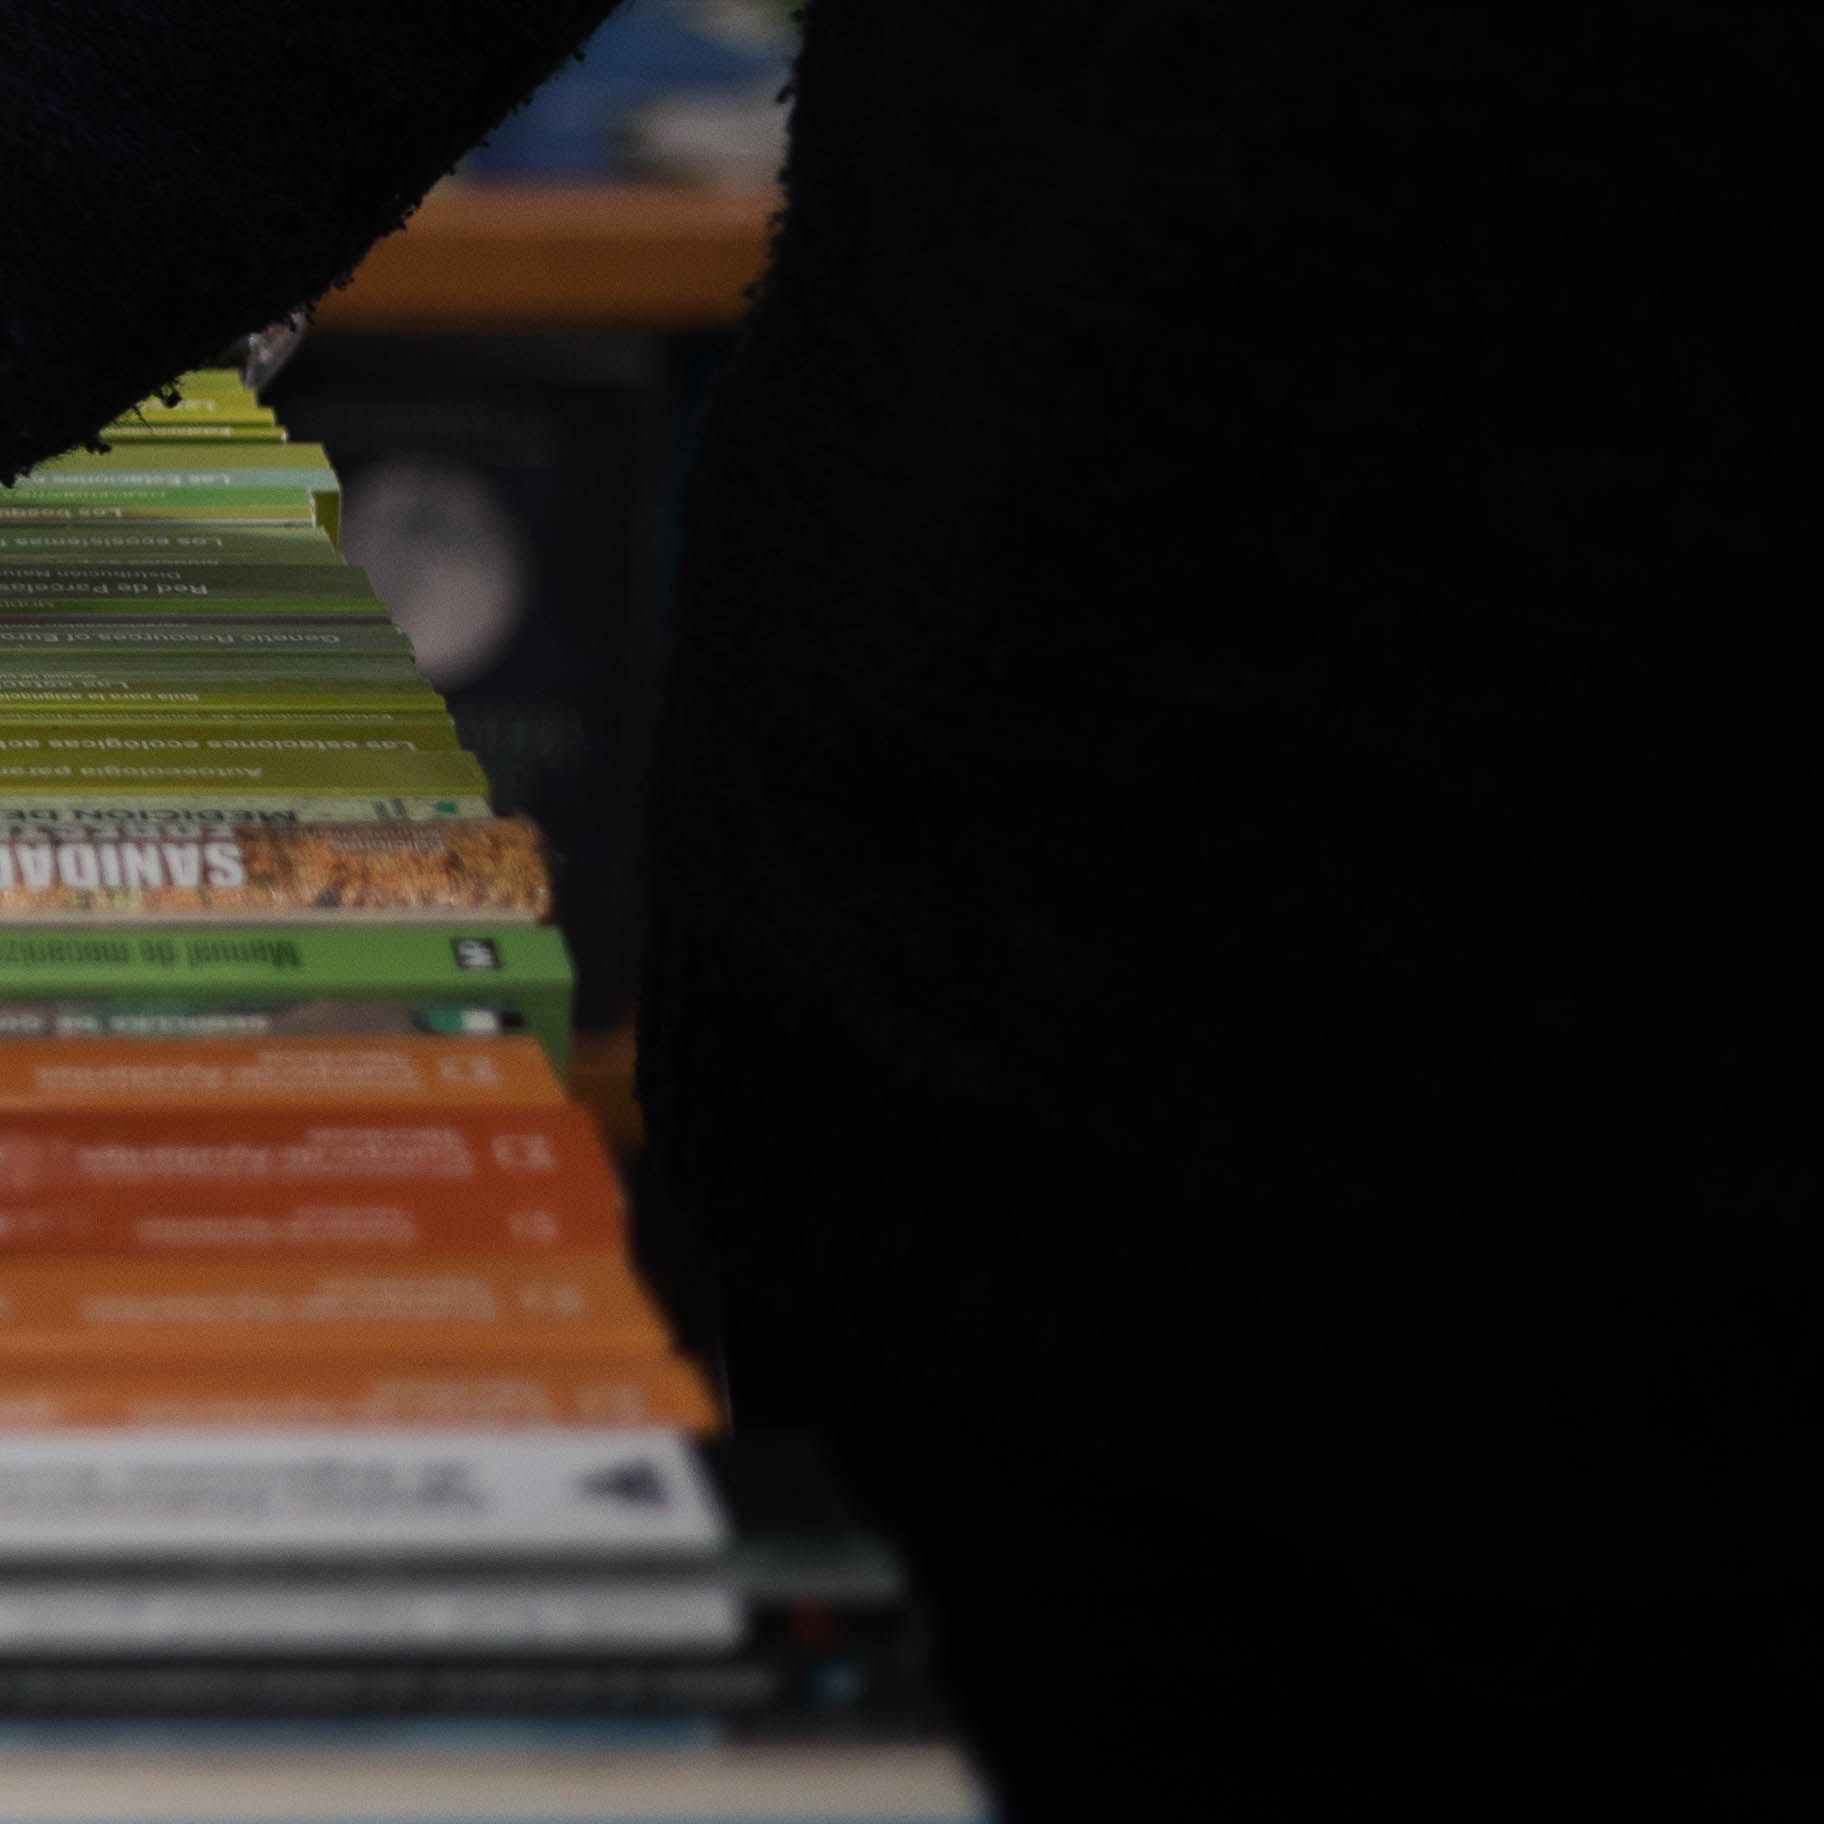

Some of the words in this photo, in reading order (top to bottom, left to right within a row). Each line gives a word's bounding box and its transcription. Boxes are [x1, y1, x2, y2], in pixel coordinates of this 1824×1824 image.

[15, 536, 170, 547] ecosistemas
[177, 537, 223, 548] Los
[116, 584, 148, 595] de
[155, 583, 208, 596] Red
[64, 632, 91, 643] of
[97, 632, 235, 643] Resources
[240, 633, 340, 644] Genetic
[47, 736, 201, 752] ecológicas
[206, 739, 359, 752] estaciones
[364, 739, 419, 752] Las
[79, 764, 264, 781] Autoecología
[4, 809, 59, 822] DE
[72, 809, 298, 827] MEDICIÓN
[141, 940, 176, 970] de
[184, 939, 303, 971] Manual
